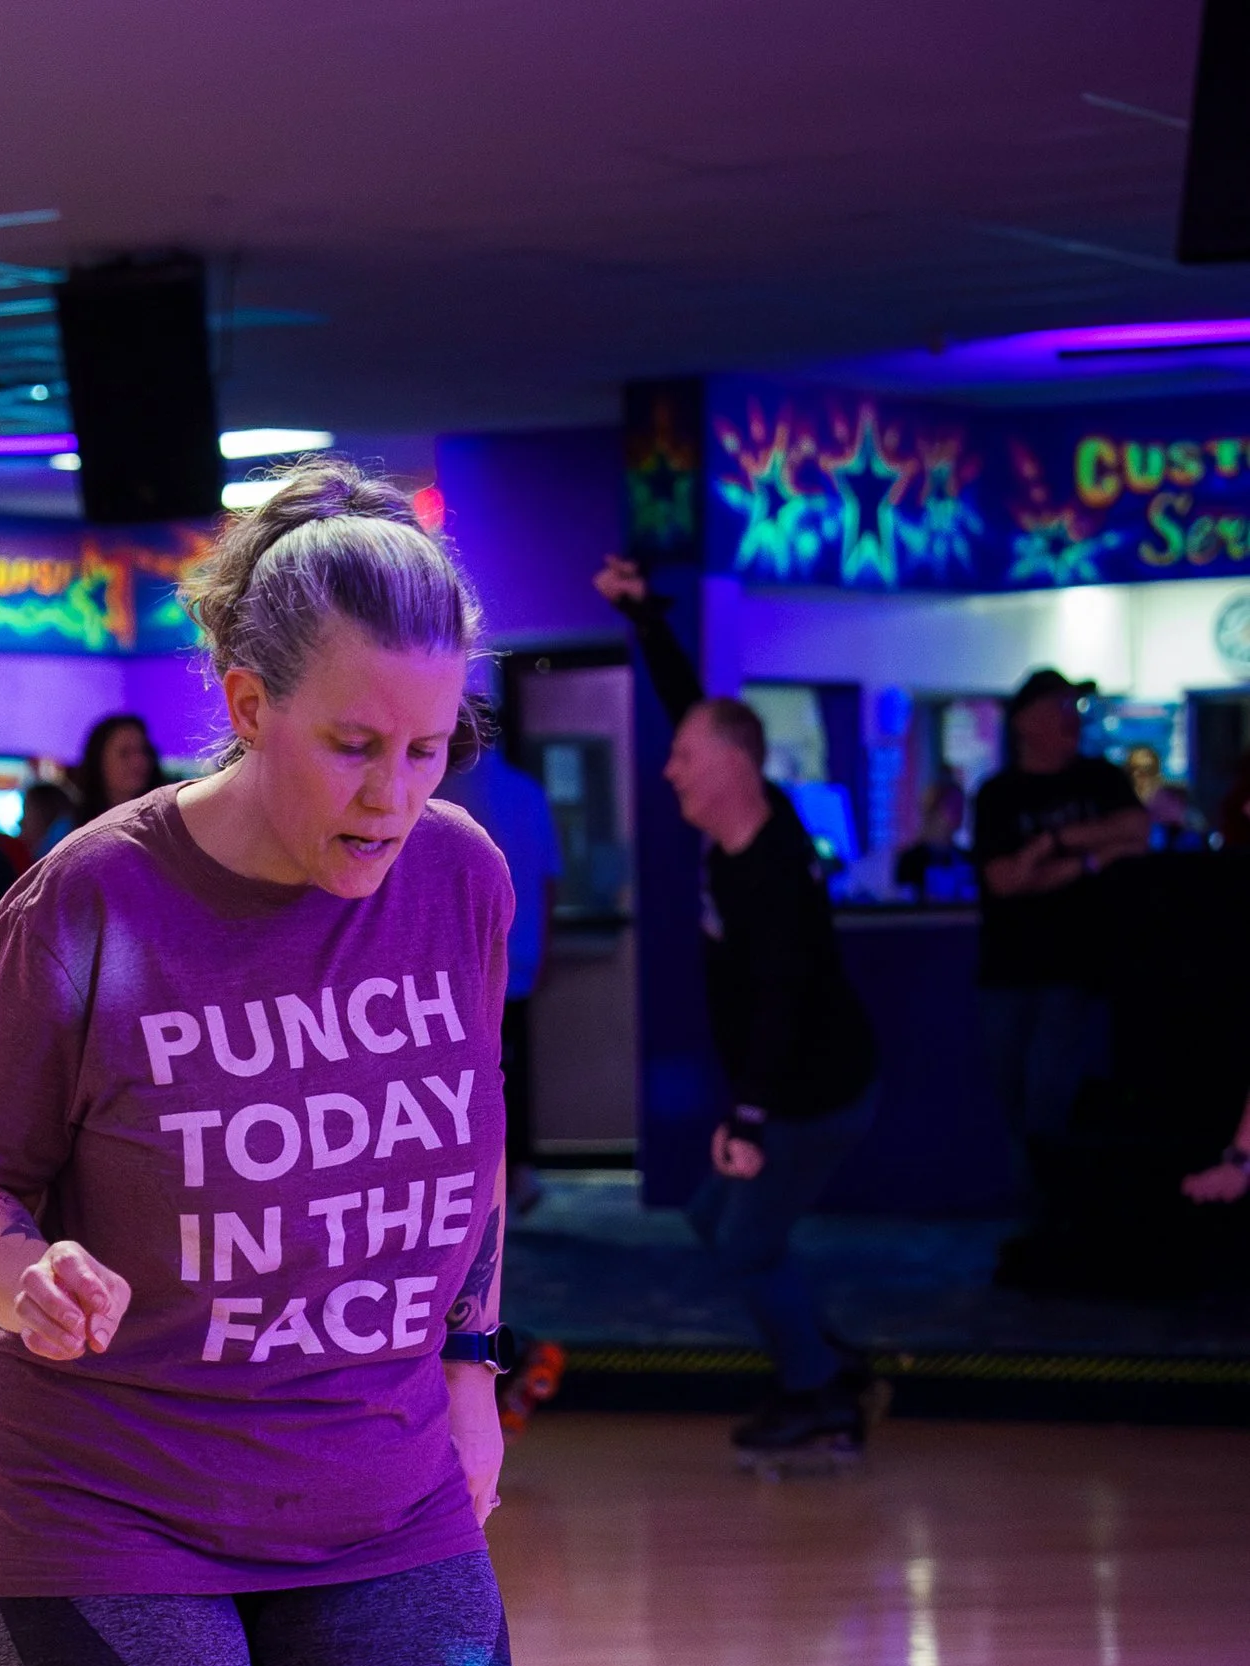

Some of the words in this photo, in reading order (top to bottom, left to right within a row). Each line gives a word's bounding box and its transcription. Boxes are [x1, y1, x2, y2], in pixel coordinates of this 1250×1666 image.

[1075, 436, 1250, 507] CUST
[1138, 492, 1250, 566] Ser
[140, 970, 466, 1086] PUNCH
[159, 1069, 475, 1187] TODAY
[180, 1206, 282, 1282] IN
[308, 1171, 475, 1268] THE
[201, 1276, 438, 1362] FACE
